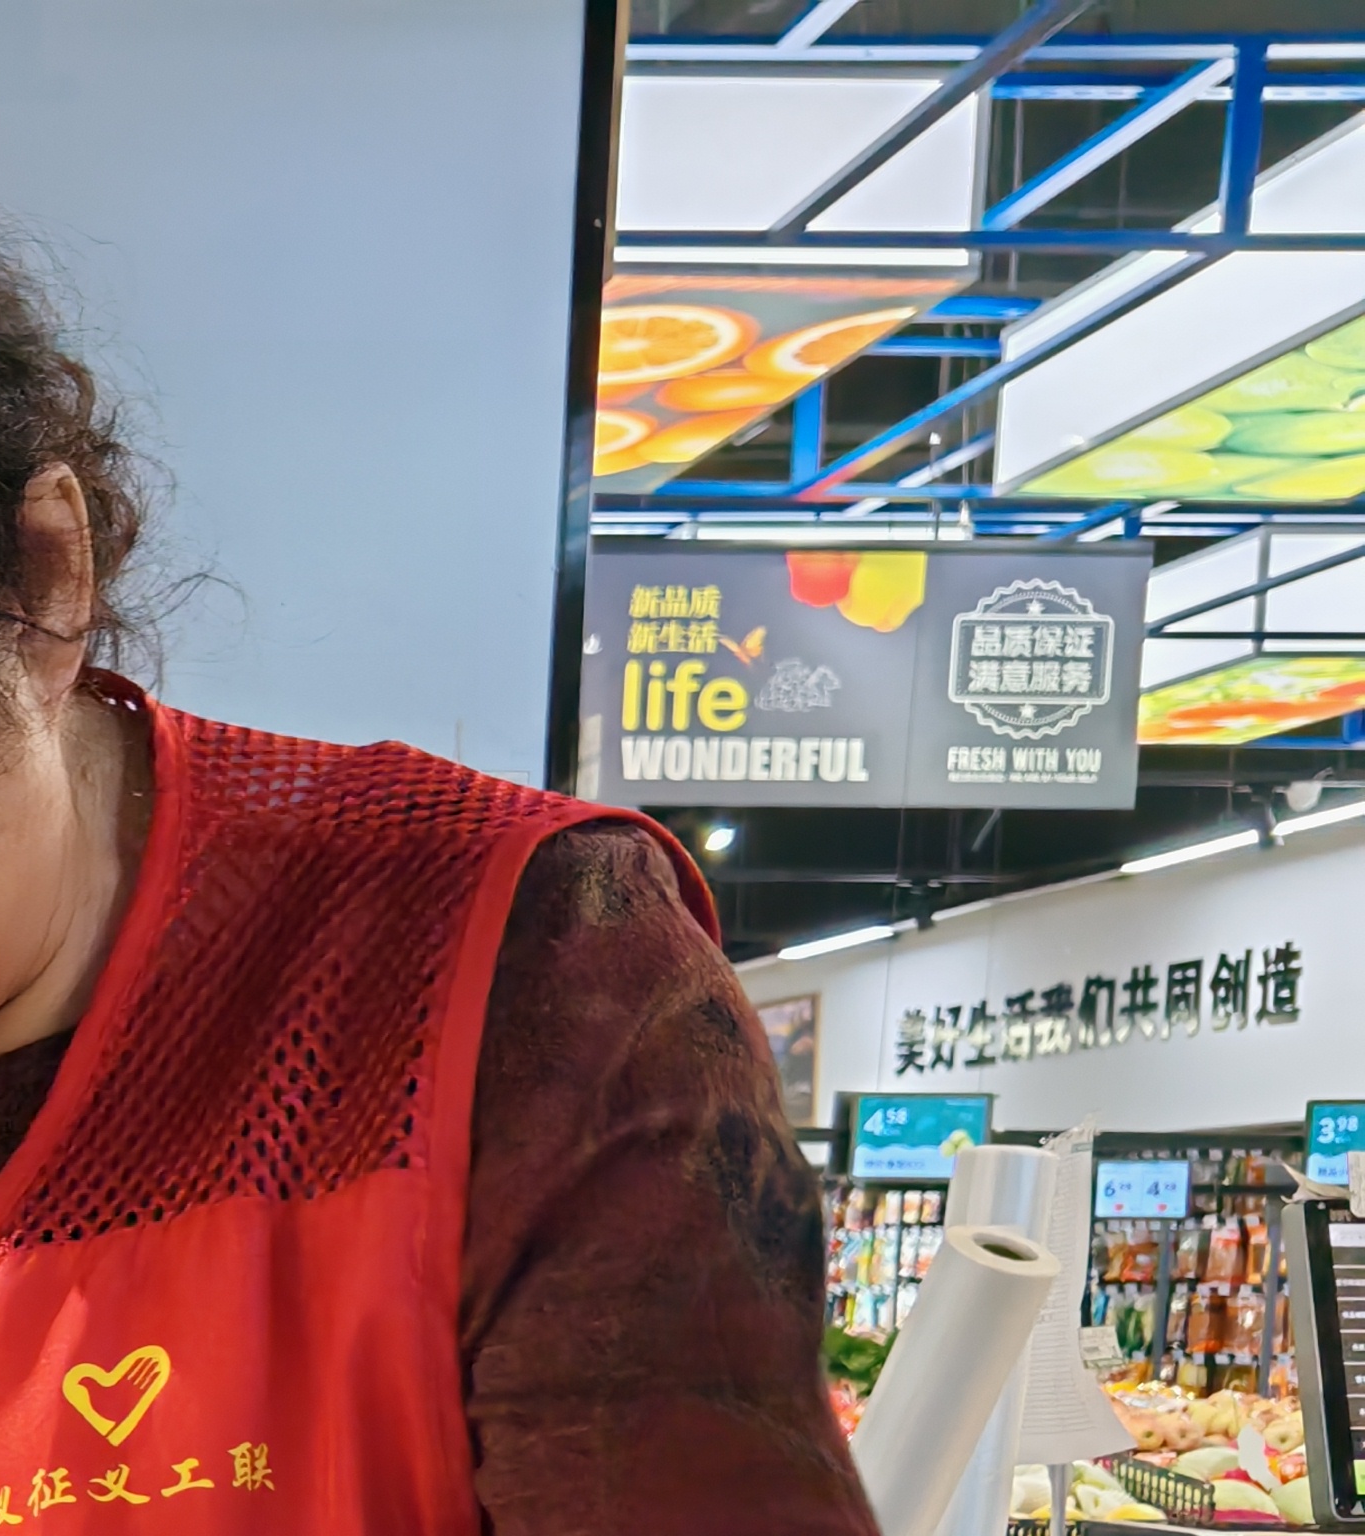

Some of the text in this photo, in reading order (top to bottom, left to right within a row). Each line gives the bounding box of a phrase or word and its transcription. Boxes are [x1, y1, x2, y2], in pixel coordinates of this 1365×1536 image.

[629, 584, 721, 619] 新品质
[627, 620, 718, 654] 新生活
[970, 624, 1096, 658] 品质保证
[968, 659, 1093, 693] 满意服务
[622, 658, 750, 732] life
[621, 735, 870, 782] WONDERFUL
[947, 745, 1102, 773] FRESH WITH YOU
